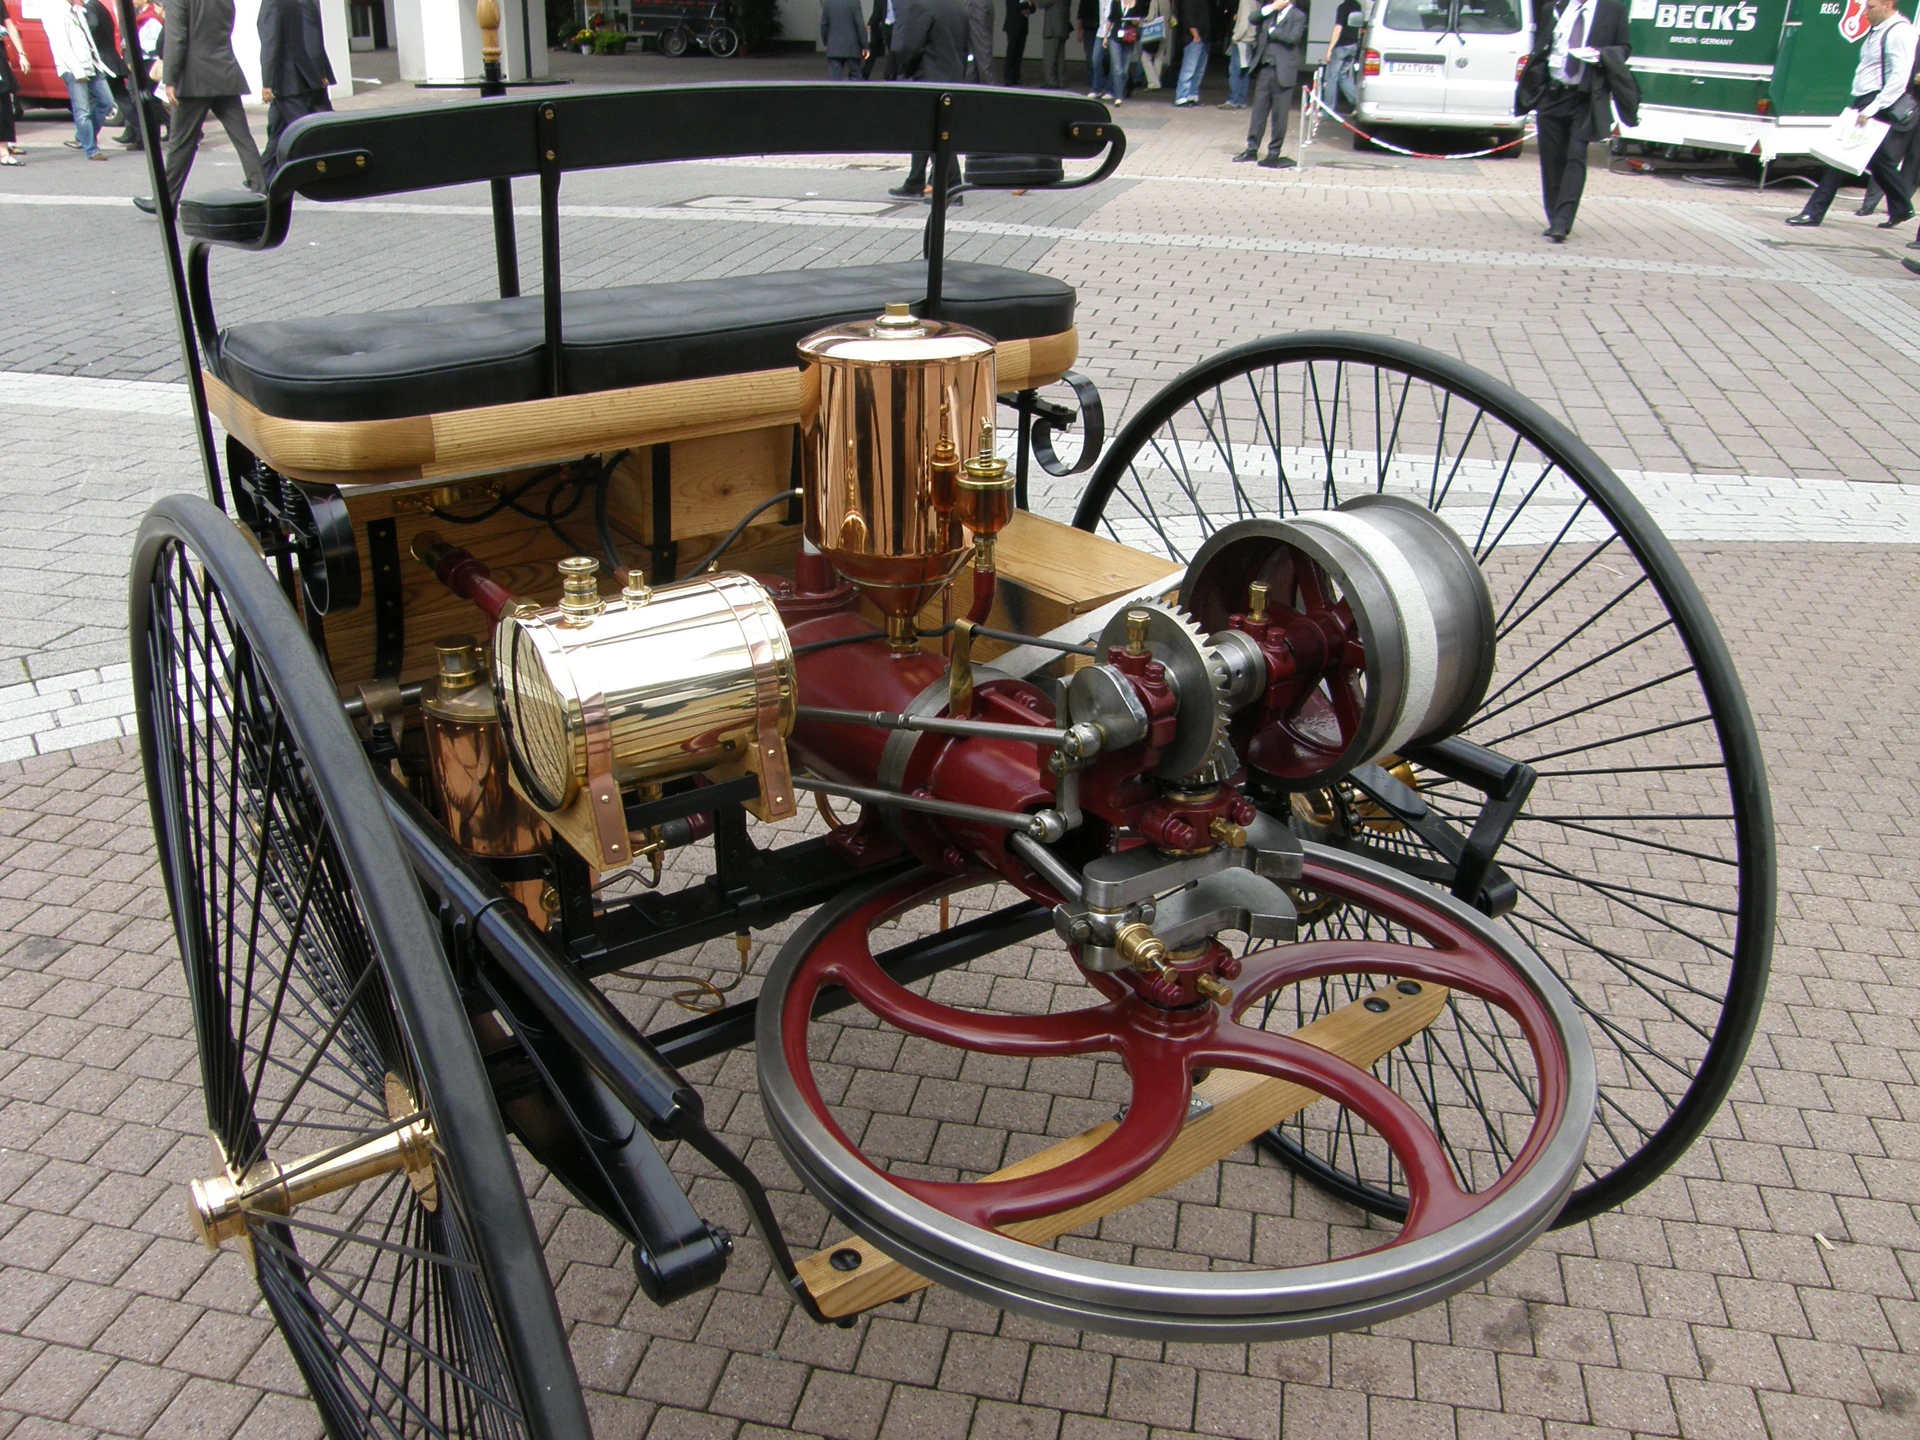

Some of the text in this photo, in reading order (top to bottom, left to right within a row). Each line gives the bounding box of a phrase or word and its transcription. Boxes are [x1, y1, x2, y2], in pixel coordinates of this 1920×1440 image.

[1819, 3, 1841, 14] REG.
[1654, 1, 1758, 31] BECK'S
[1669, 36, 1734, 46] BREMEN GERMANY
